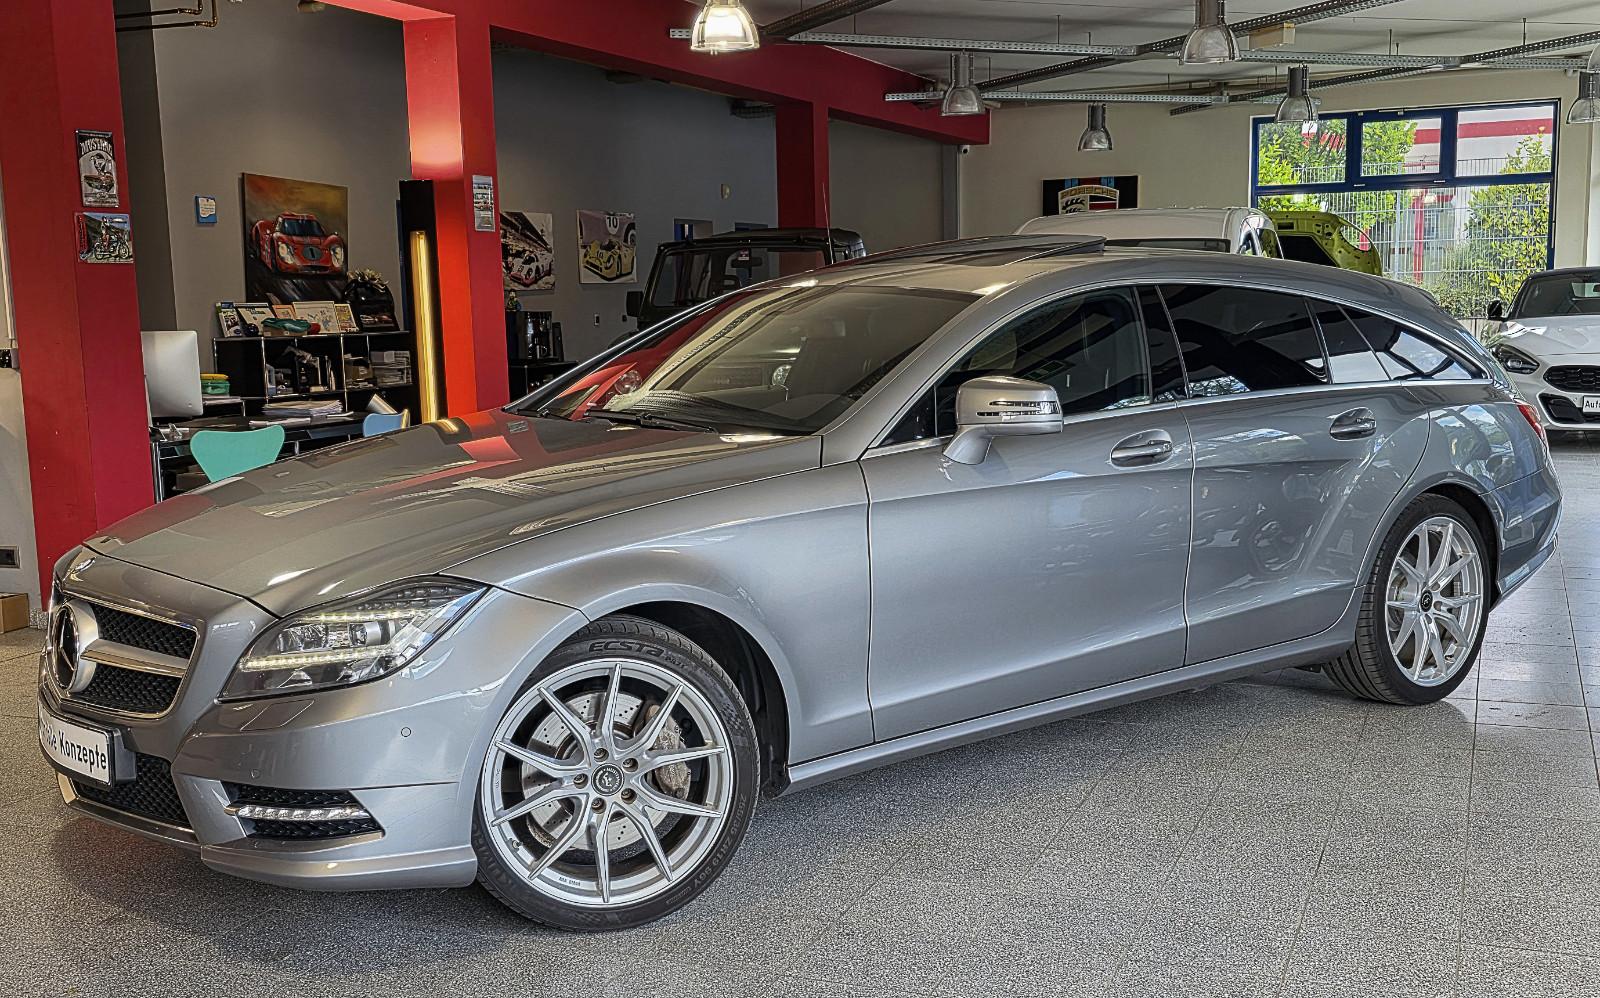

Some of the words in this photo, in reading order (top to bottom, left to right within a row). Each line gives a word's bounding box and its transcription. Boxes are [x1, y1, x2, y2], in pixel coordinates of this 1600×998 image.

[1060, 187, 1117, 199] PORSCHE
[607, 216, 618, 229] 10
[58, 730, 107, 773] Konzepte
